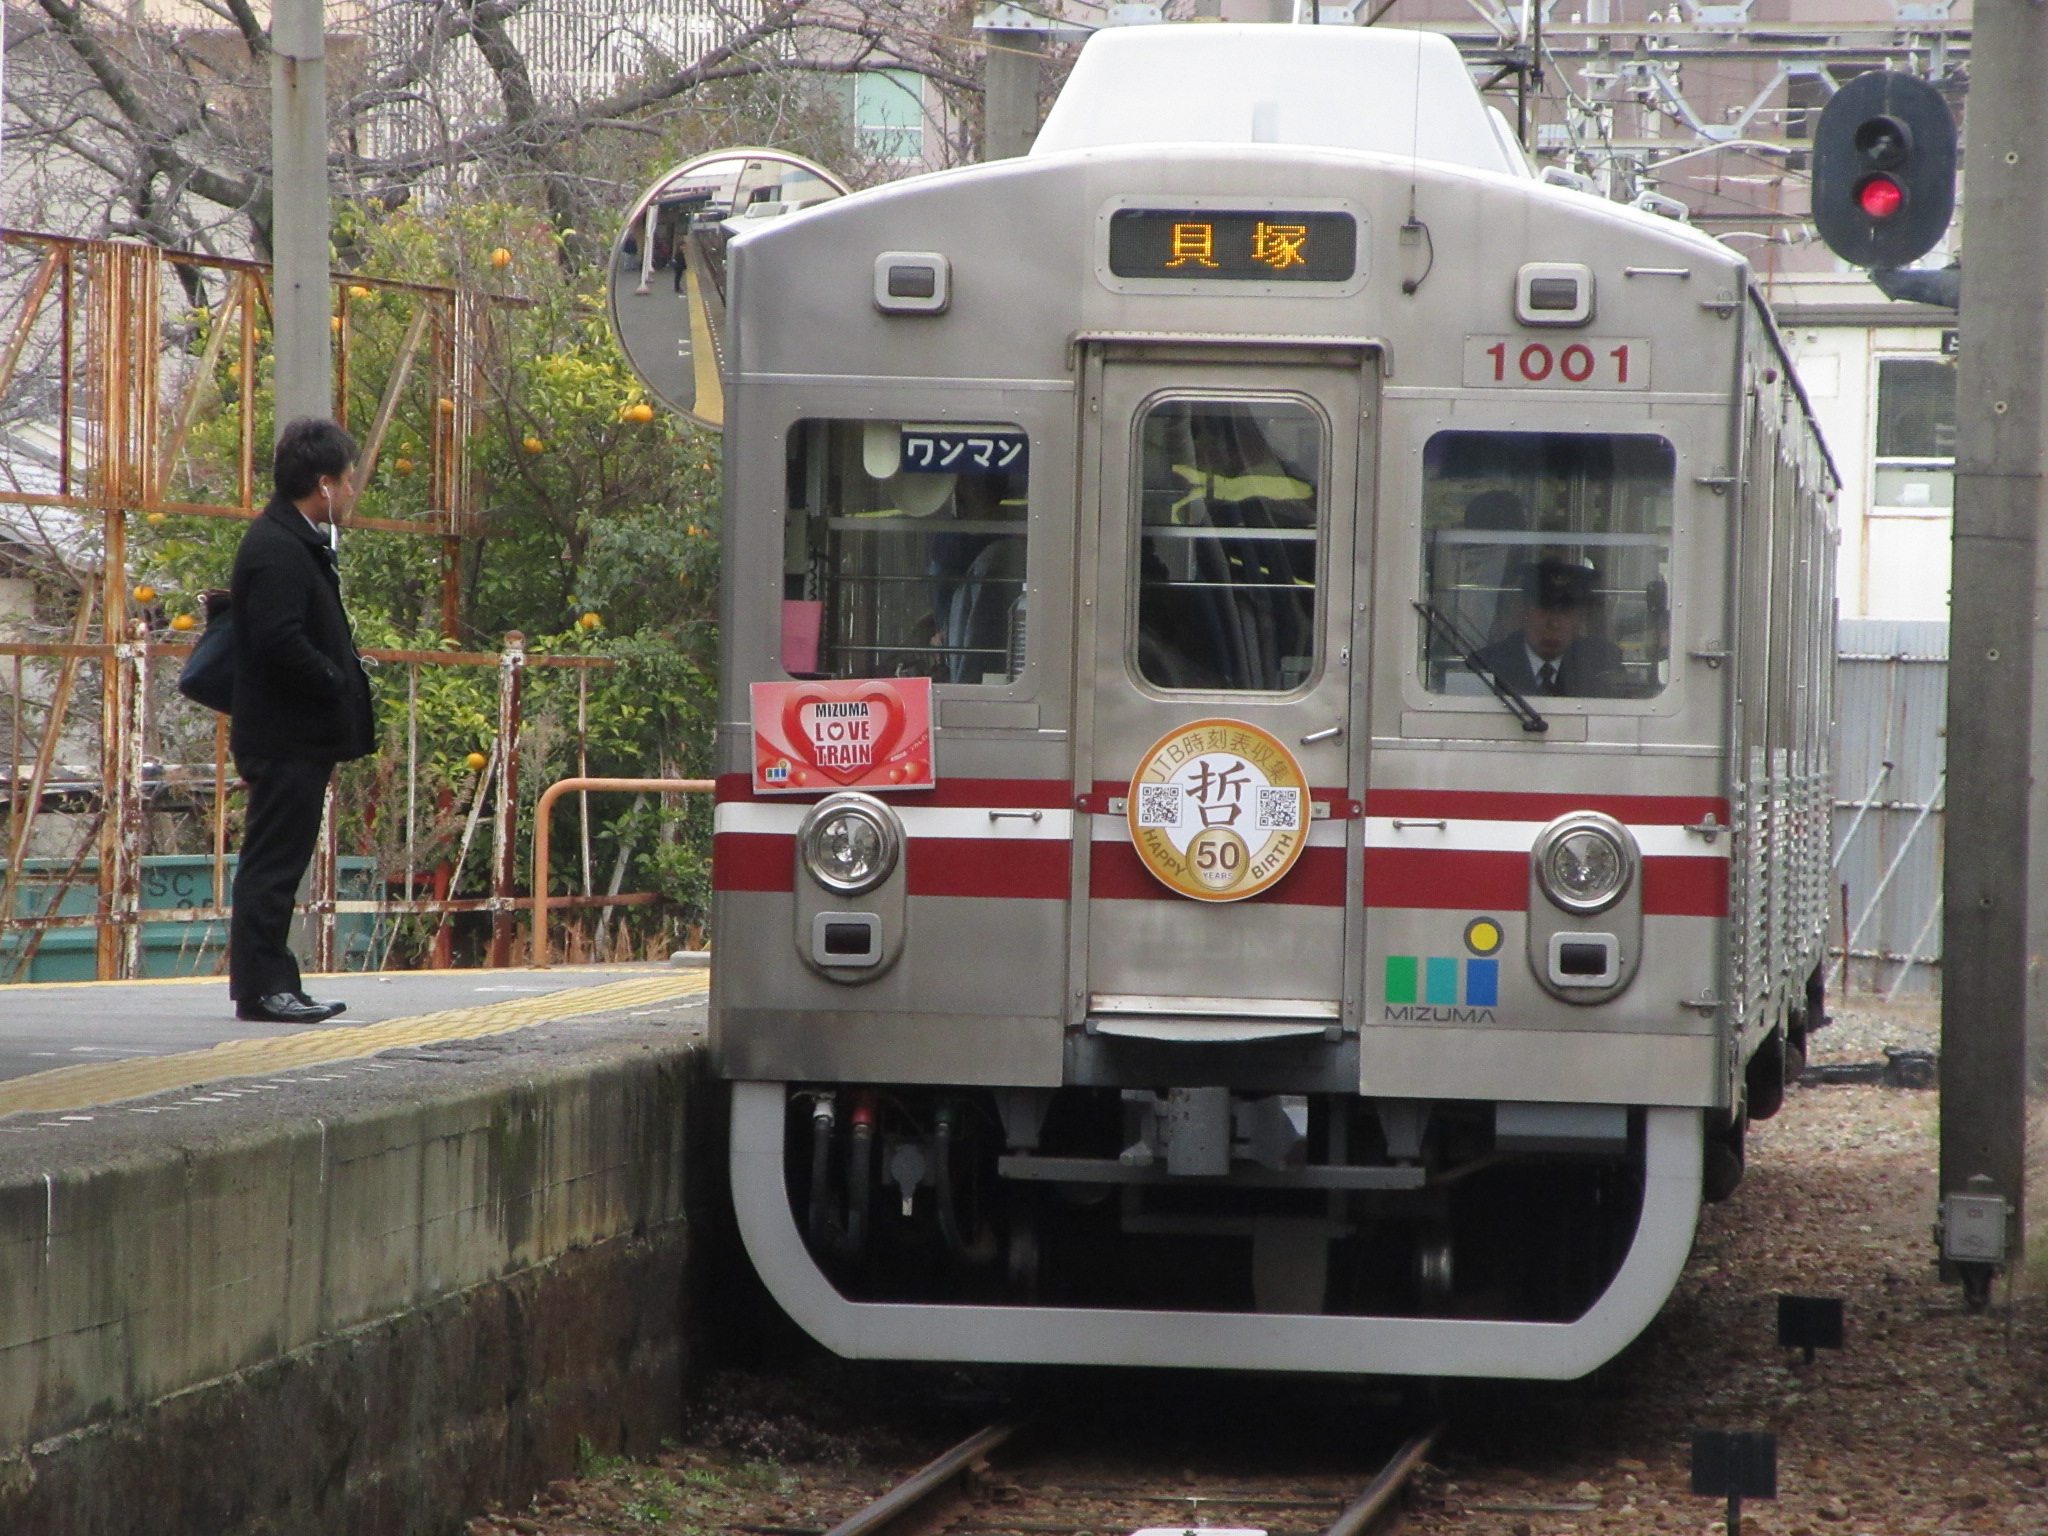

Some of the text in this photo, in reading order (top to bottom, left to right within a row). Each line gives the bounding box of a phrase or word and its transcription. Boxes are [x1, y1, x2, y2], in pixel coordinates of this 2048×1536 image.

[1165, 222, 1309, 268] 貝塚
[1486, 342, 1629, 383] 1001
[907, 438, 1022, 467] ワンマン
[815, 702, 869, 718] MIZUMA
[815, 720, 870, 741] LOVE
[814, 743, 873, 766] TRAIN
[1185, 760, 1252, 828] 哲
[1143, 828, 1187, 878] HAPPY
[1196, 841, 1240, 870] 50
[1250, 833, 1293, 880] BIRTH
[1201, 871, 1234, 881] YEARS
[1385, 1005, 1497, 1024] MIZUMA
